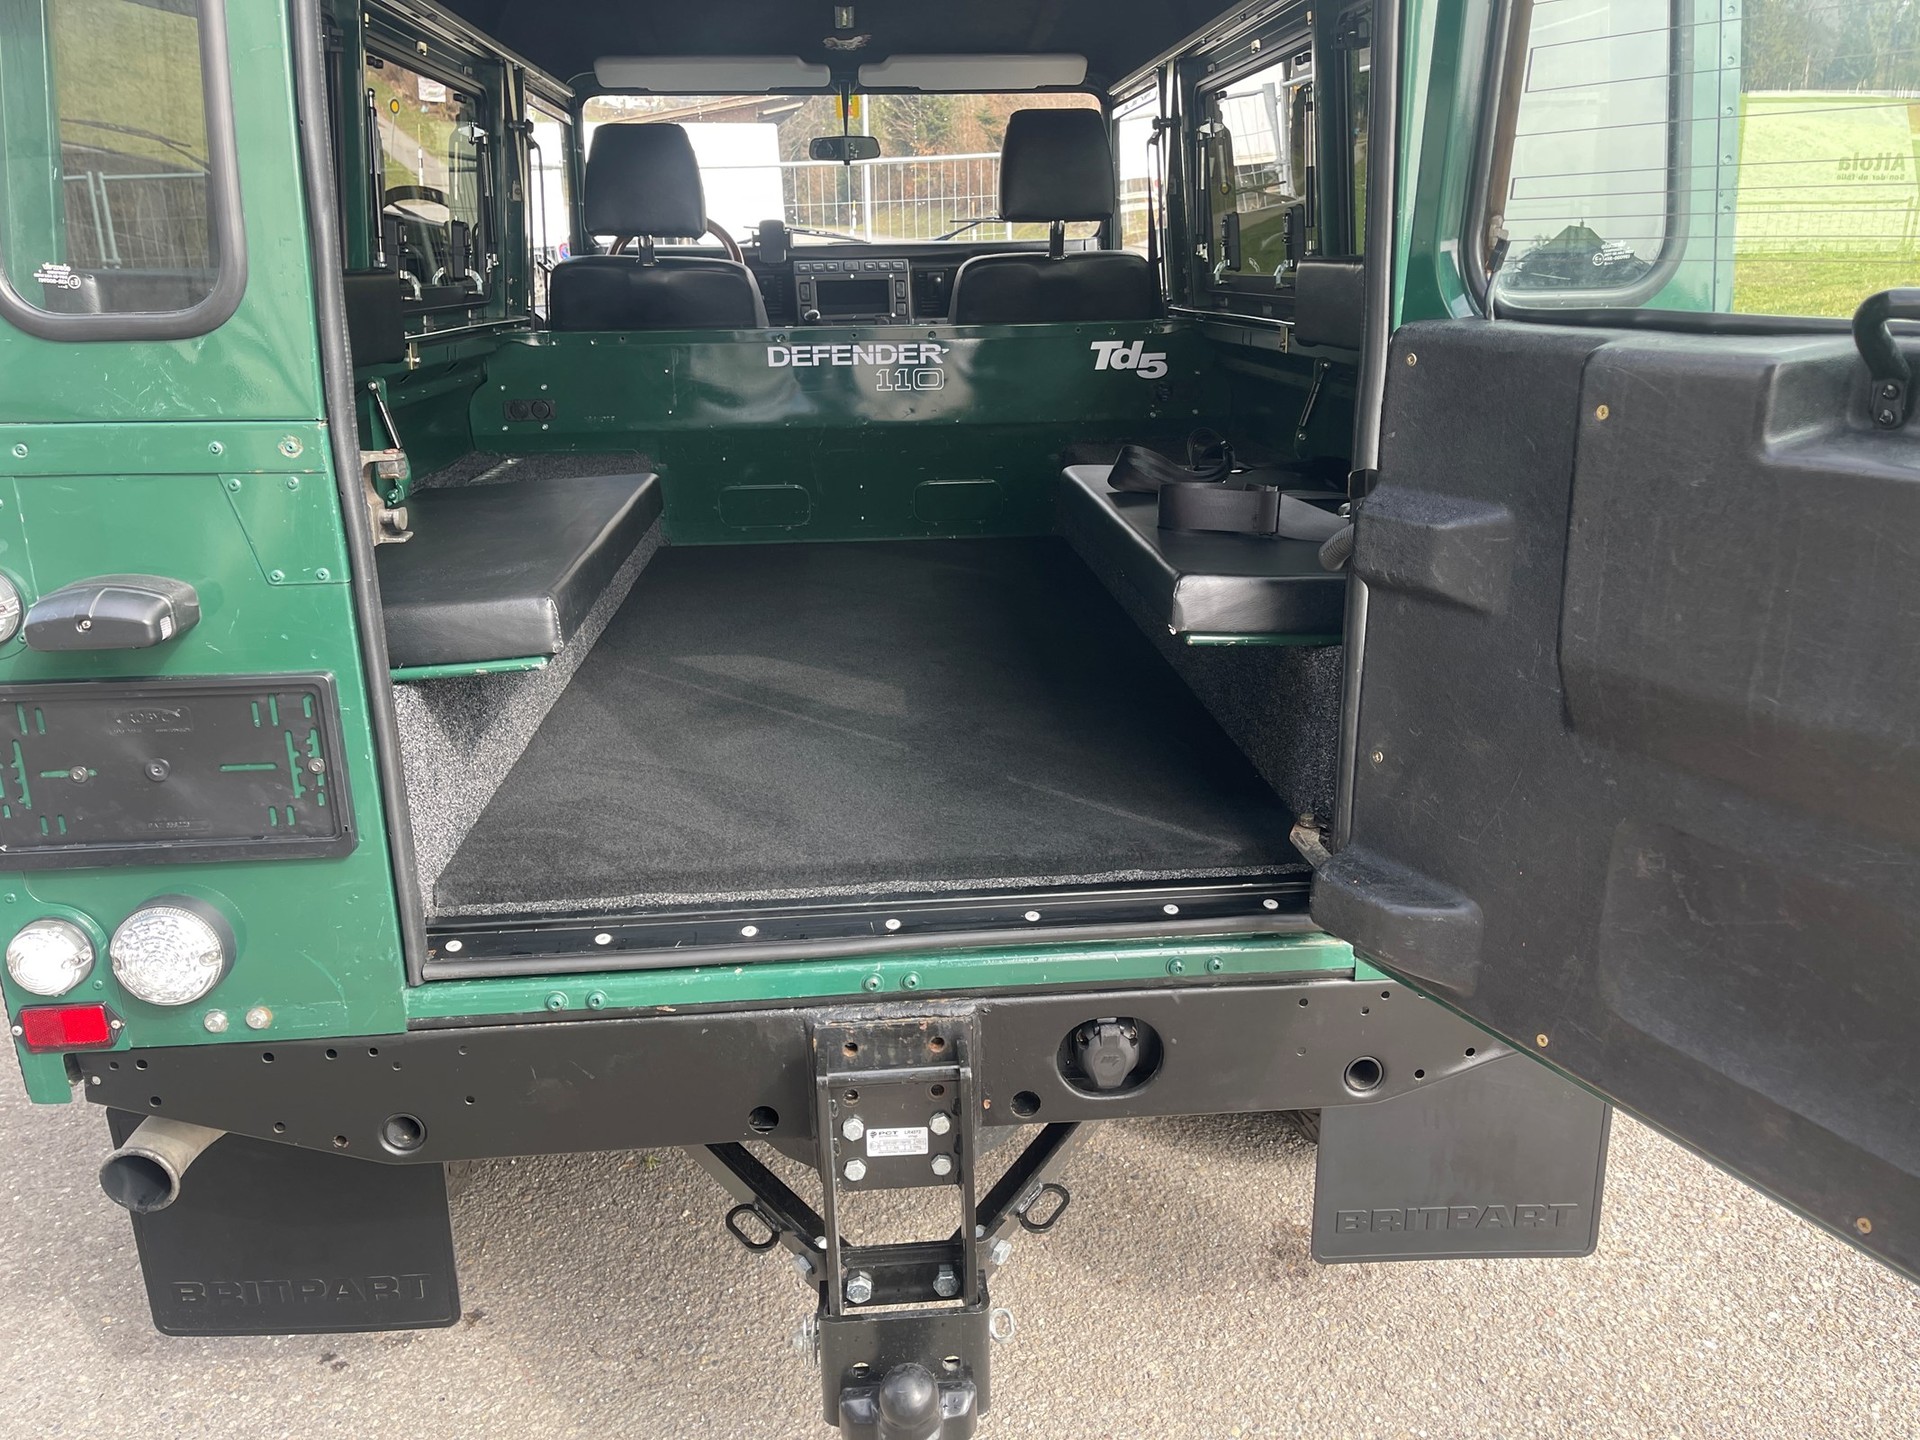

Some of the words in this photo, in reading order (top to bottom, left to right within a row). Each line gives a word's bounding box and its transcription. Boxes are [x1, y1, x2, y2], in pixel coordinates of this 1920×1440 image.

[767, 343, 948, 368] DEFENDER
[1090, 340, 1169, 379] Td5
[876, 367, 946, 392] 110
[1335, 1203, 1579, 1234] BRITPART
[169, 1272, 433, 1305] BRITPART
